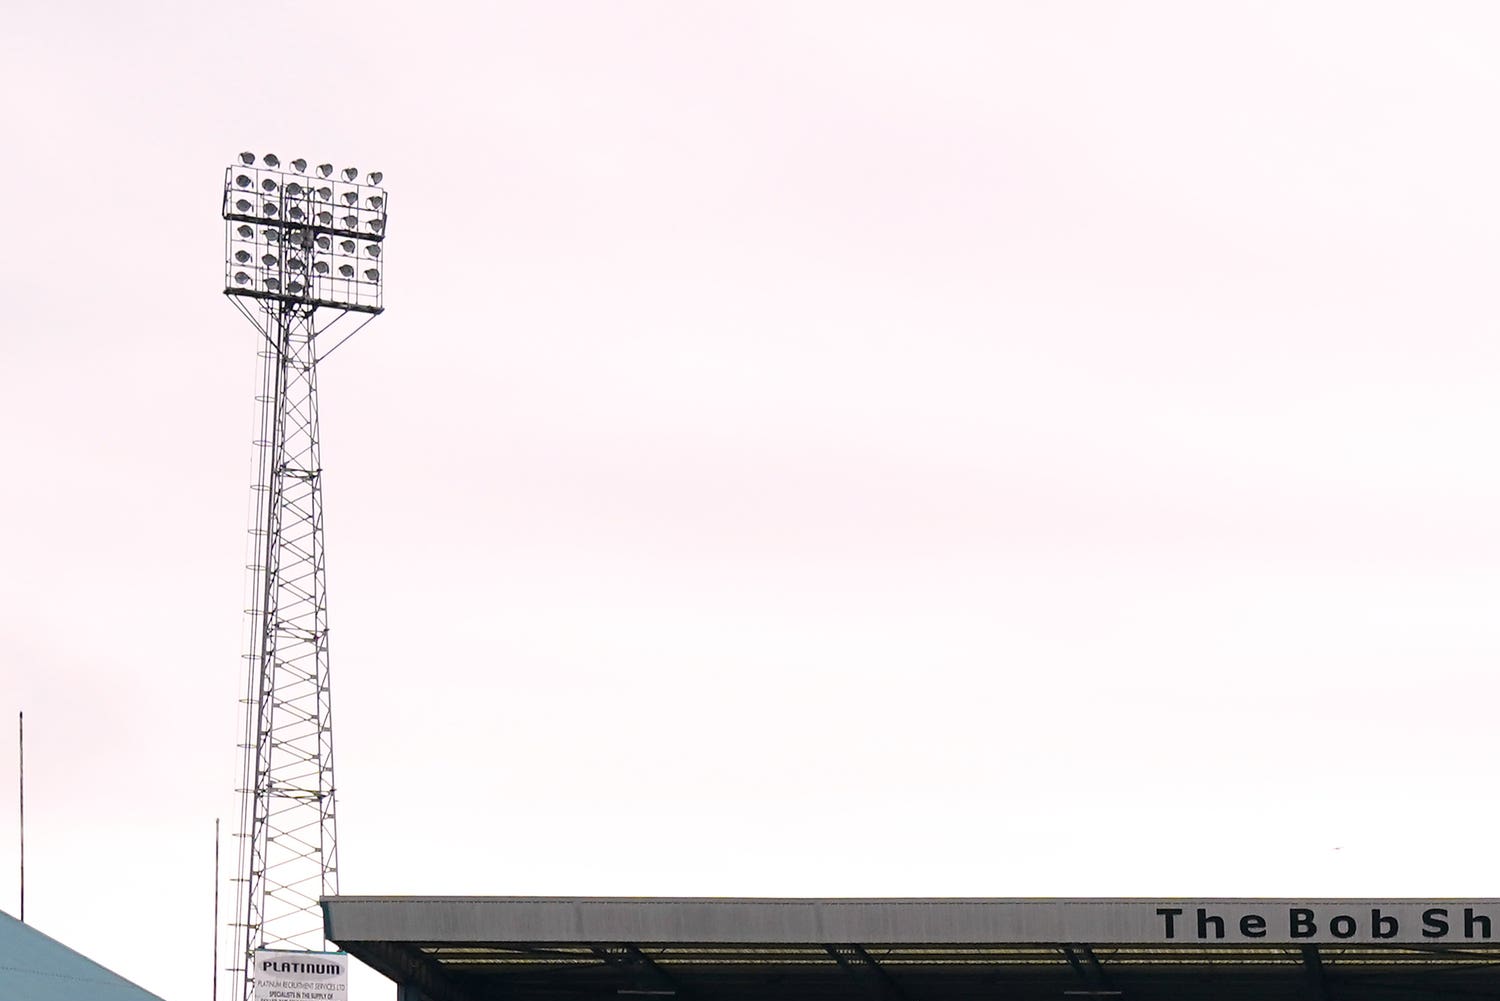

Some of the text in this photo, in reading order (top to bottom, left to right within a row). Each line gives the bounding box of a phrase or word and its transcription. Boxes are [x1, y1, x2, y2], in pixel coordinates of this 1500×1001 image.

[1156, 908, 1267, 939] The
[1289, 908, 1399, 939] Bob
[262, 961, 340, 975] PLATINUM
